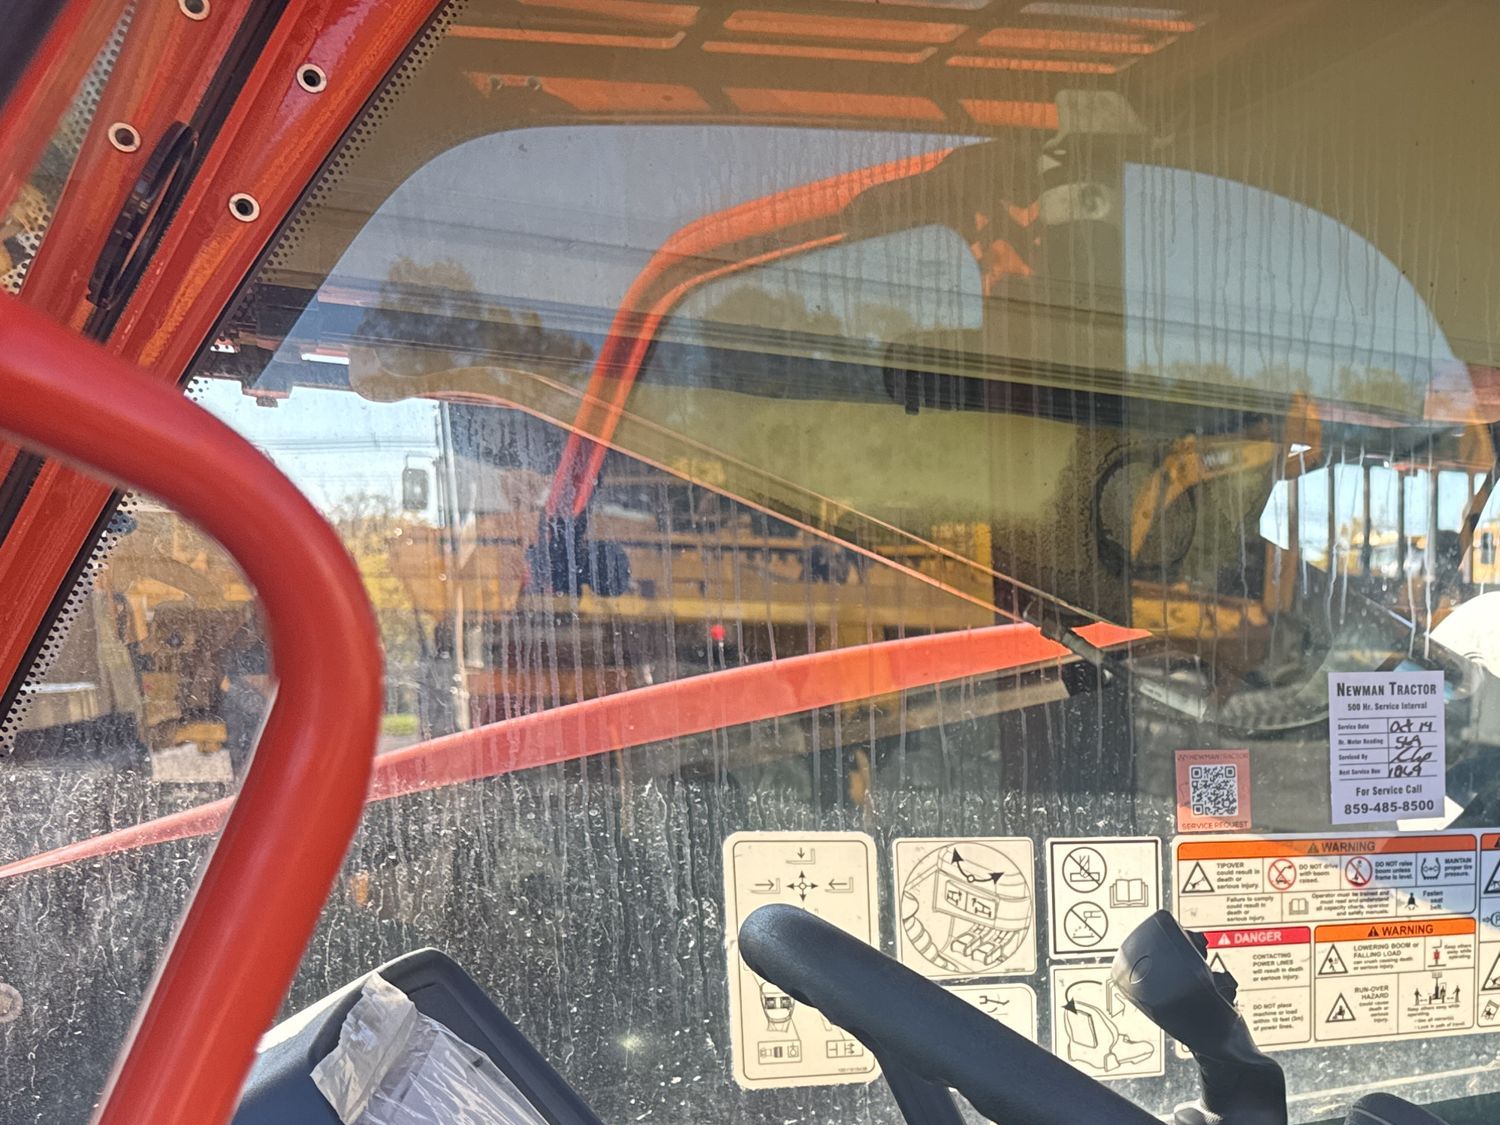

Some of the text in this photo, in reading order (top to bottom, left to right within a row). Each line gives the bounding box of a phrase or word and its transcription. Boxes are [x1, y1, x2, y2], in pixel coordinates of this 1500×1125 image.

[1337, 682, 1436, 696] NEWMAN TRACTOR
[1356, 784, 1422, 796] For Service Call
[1345, 800, 1434, 815] 859-485-8500
[1322, 842, 1375, 852] WARNING
[1382, 924, 1433, 936] WARNING
[1234, 932, 1281, 944] DANGER
[1354, 985, 1389, 993] RUN-OVER
